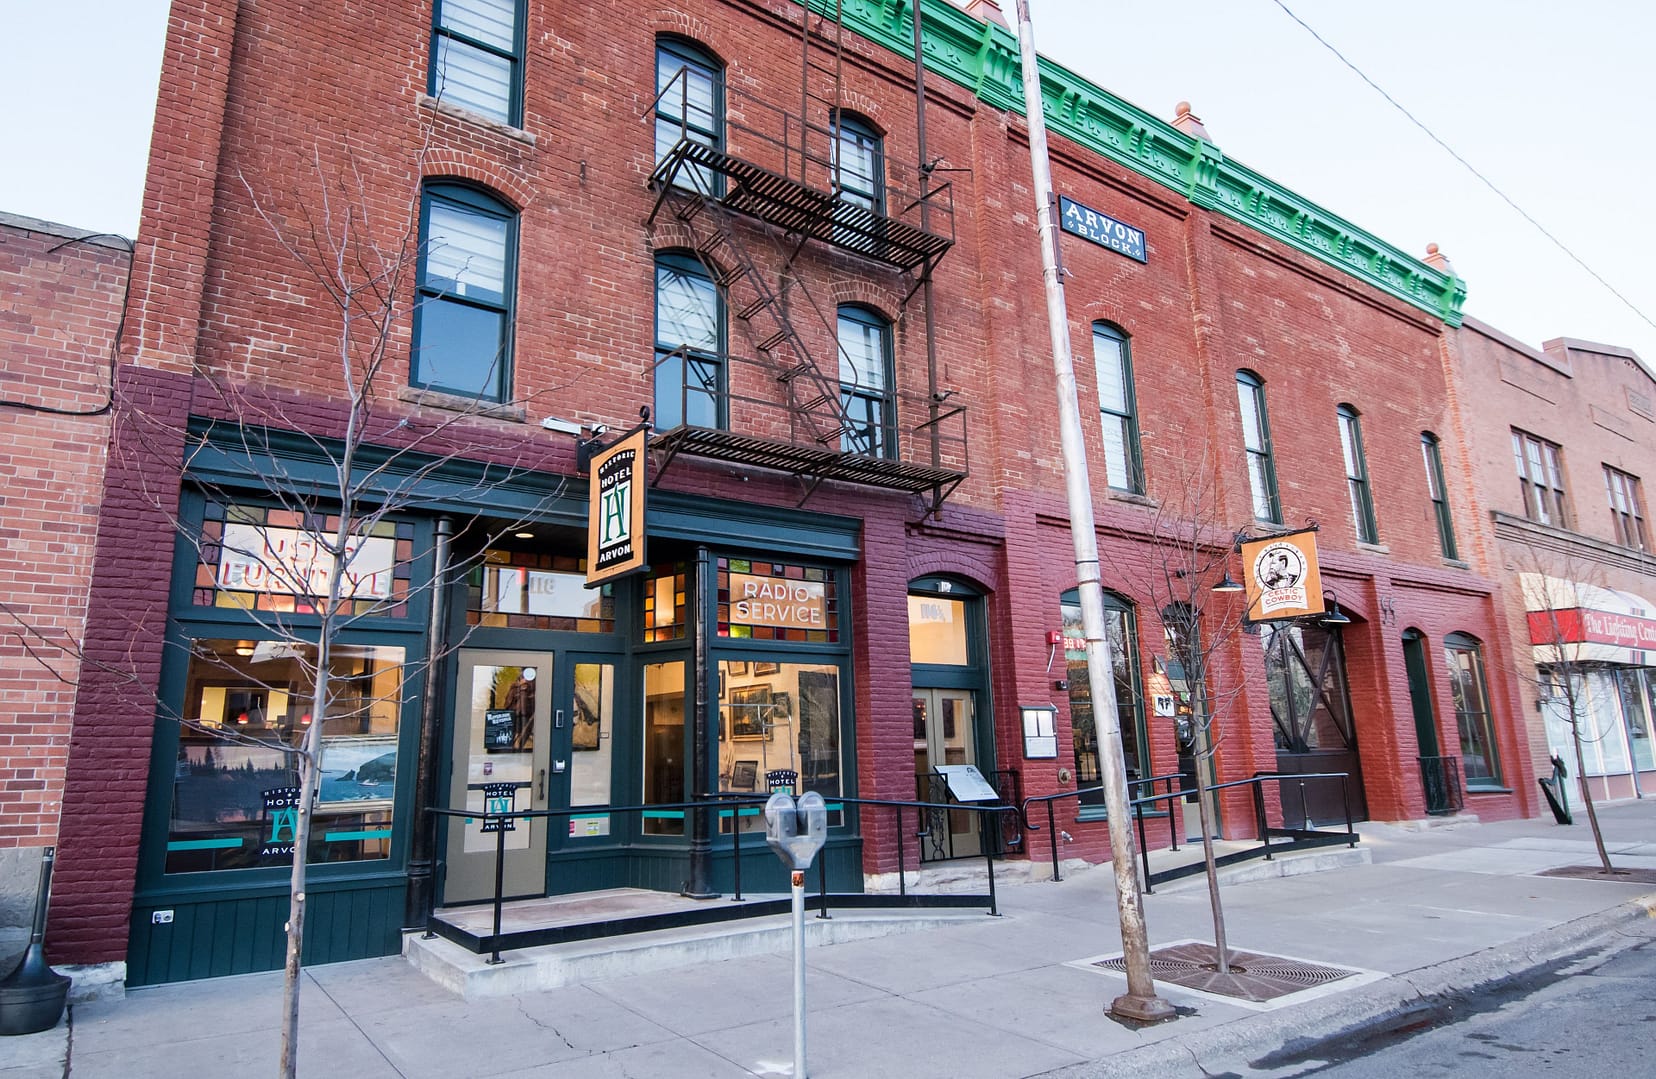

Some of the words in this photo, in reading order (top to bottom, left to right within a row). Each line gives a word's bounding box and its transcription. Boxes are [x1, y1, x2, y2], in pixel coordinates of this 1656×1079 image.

[1066, 203, 1140, 246] ARVON
[599, 451, 635, 474] HISTORIC
[601, 466, 632, 489] HOTEL
[599, 543, 631, 563] ARVON
[223, 560, 390, 597] FURNITE
[743, 581, 809, 602] RADIO
[1265, 594, 1303, 605] COWBOY
[1268, 588, 1299, 598] CELTIC
[736, 600, 821, 624] SERVICE
[1584, 613, 1603, 635] The
[1604, 616, 1639, 647] Lighting
[264, 788, 302, 796] HISTO
[266, 798, 302, 806] HOTE
[262, 846, 296, 855] ARVO
